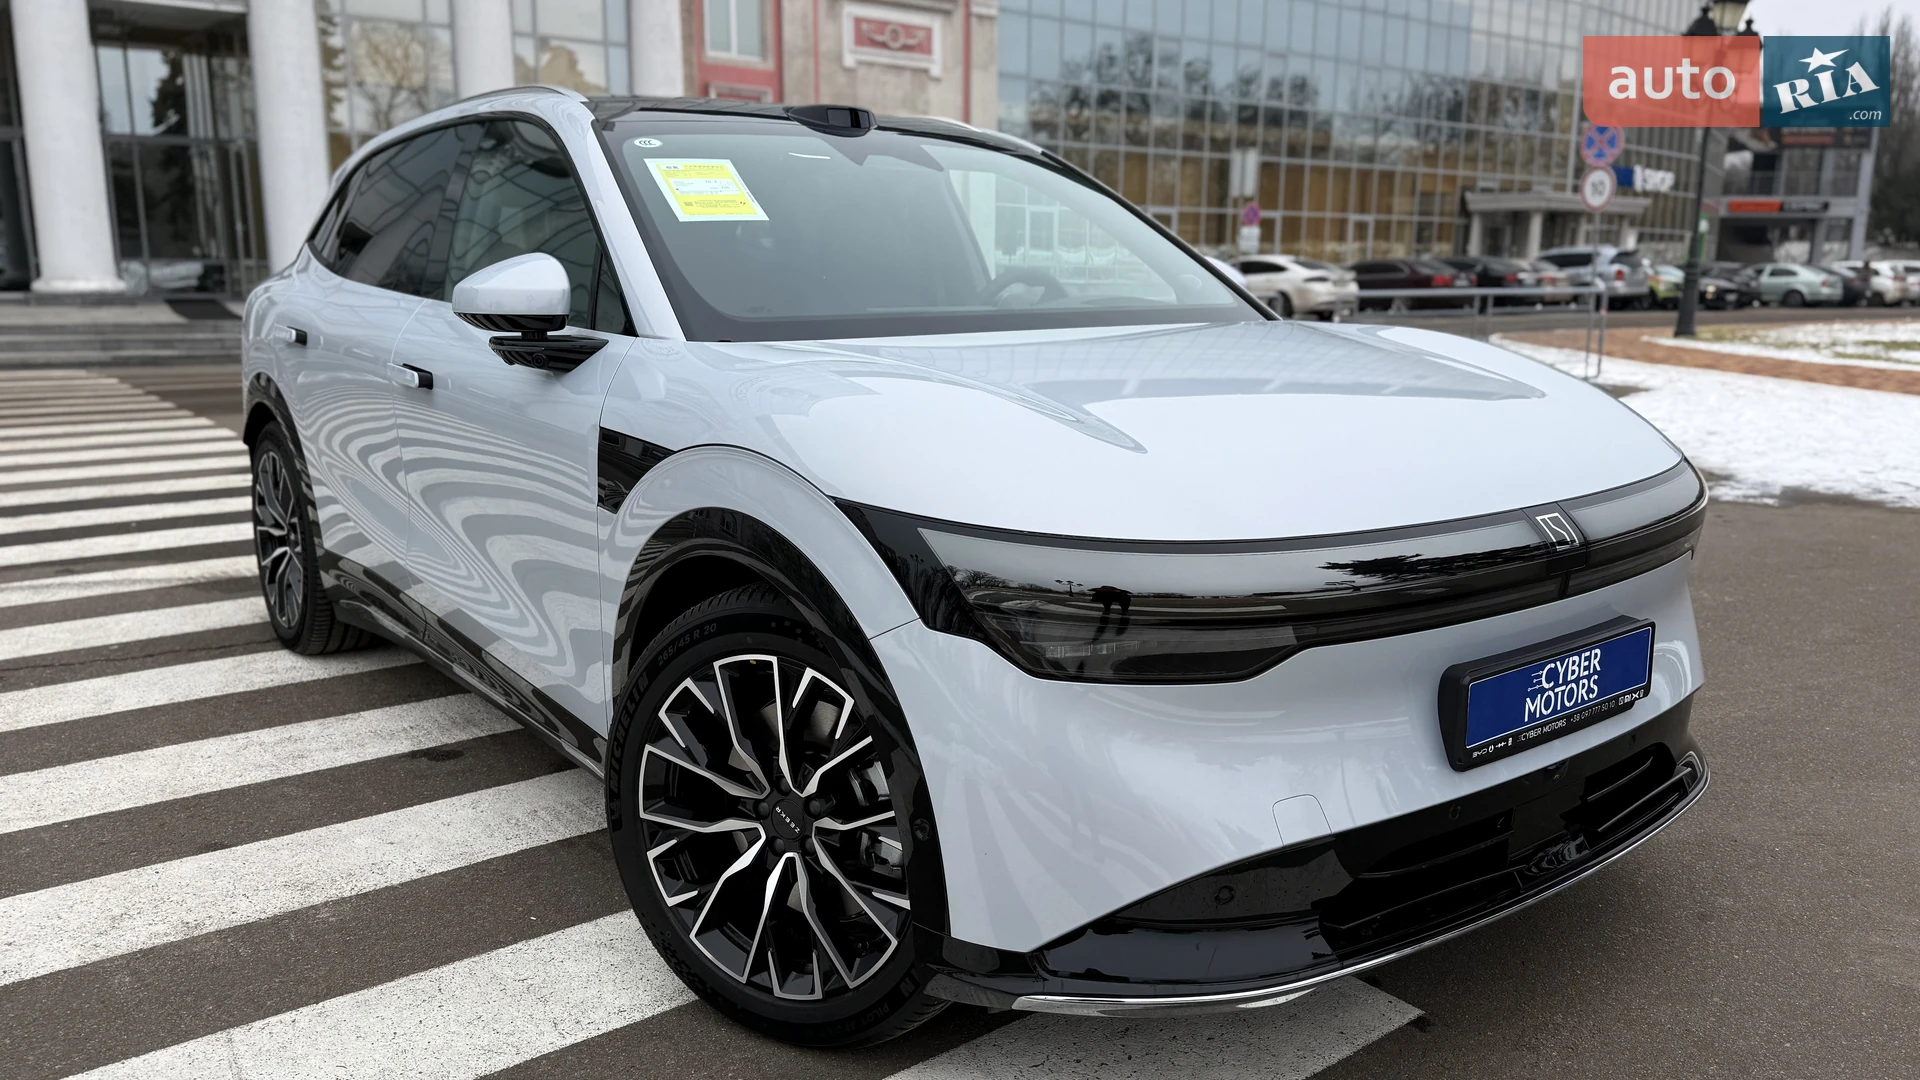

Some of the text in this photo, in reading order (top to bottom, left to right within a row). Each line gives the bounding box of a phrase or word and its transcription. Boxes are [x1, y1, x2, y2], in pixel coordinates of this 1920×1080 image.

[657, 622, 718, 668] 265/45 R 20
[1541, 648, 1601, 689] CYBER
[1524, 675, 1599, 722] MOTORS
[609, 672, 650, 794] MICHELIN
[1521, 728, 1542, 741] CYBER
[1542, 718, 1567, 734] MOTORS
[775, 806, 801, 834] ZEEKR
[860, 1001, 890, 1027] PILOT
